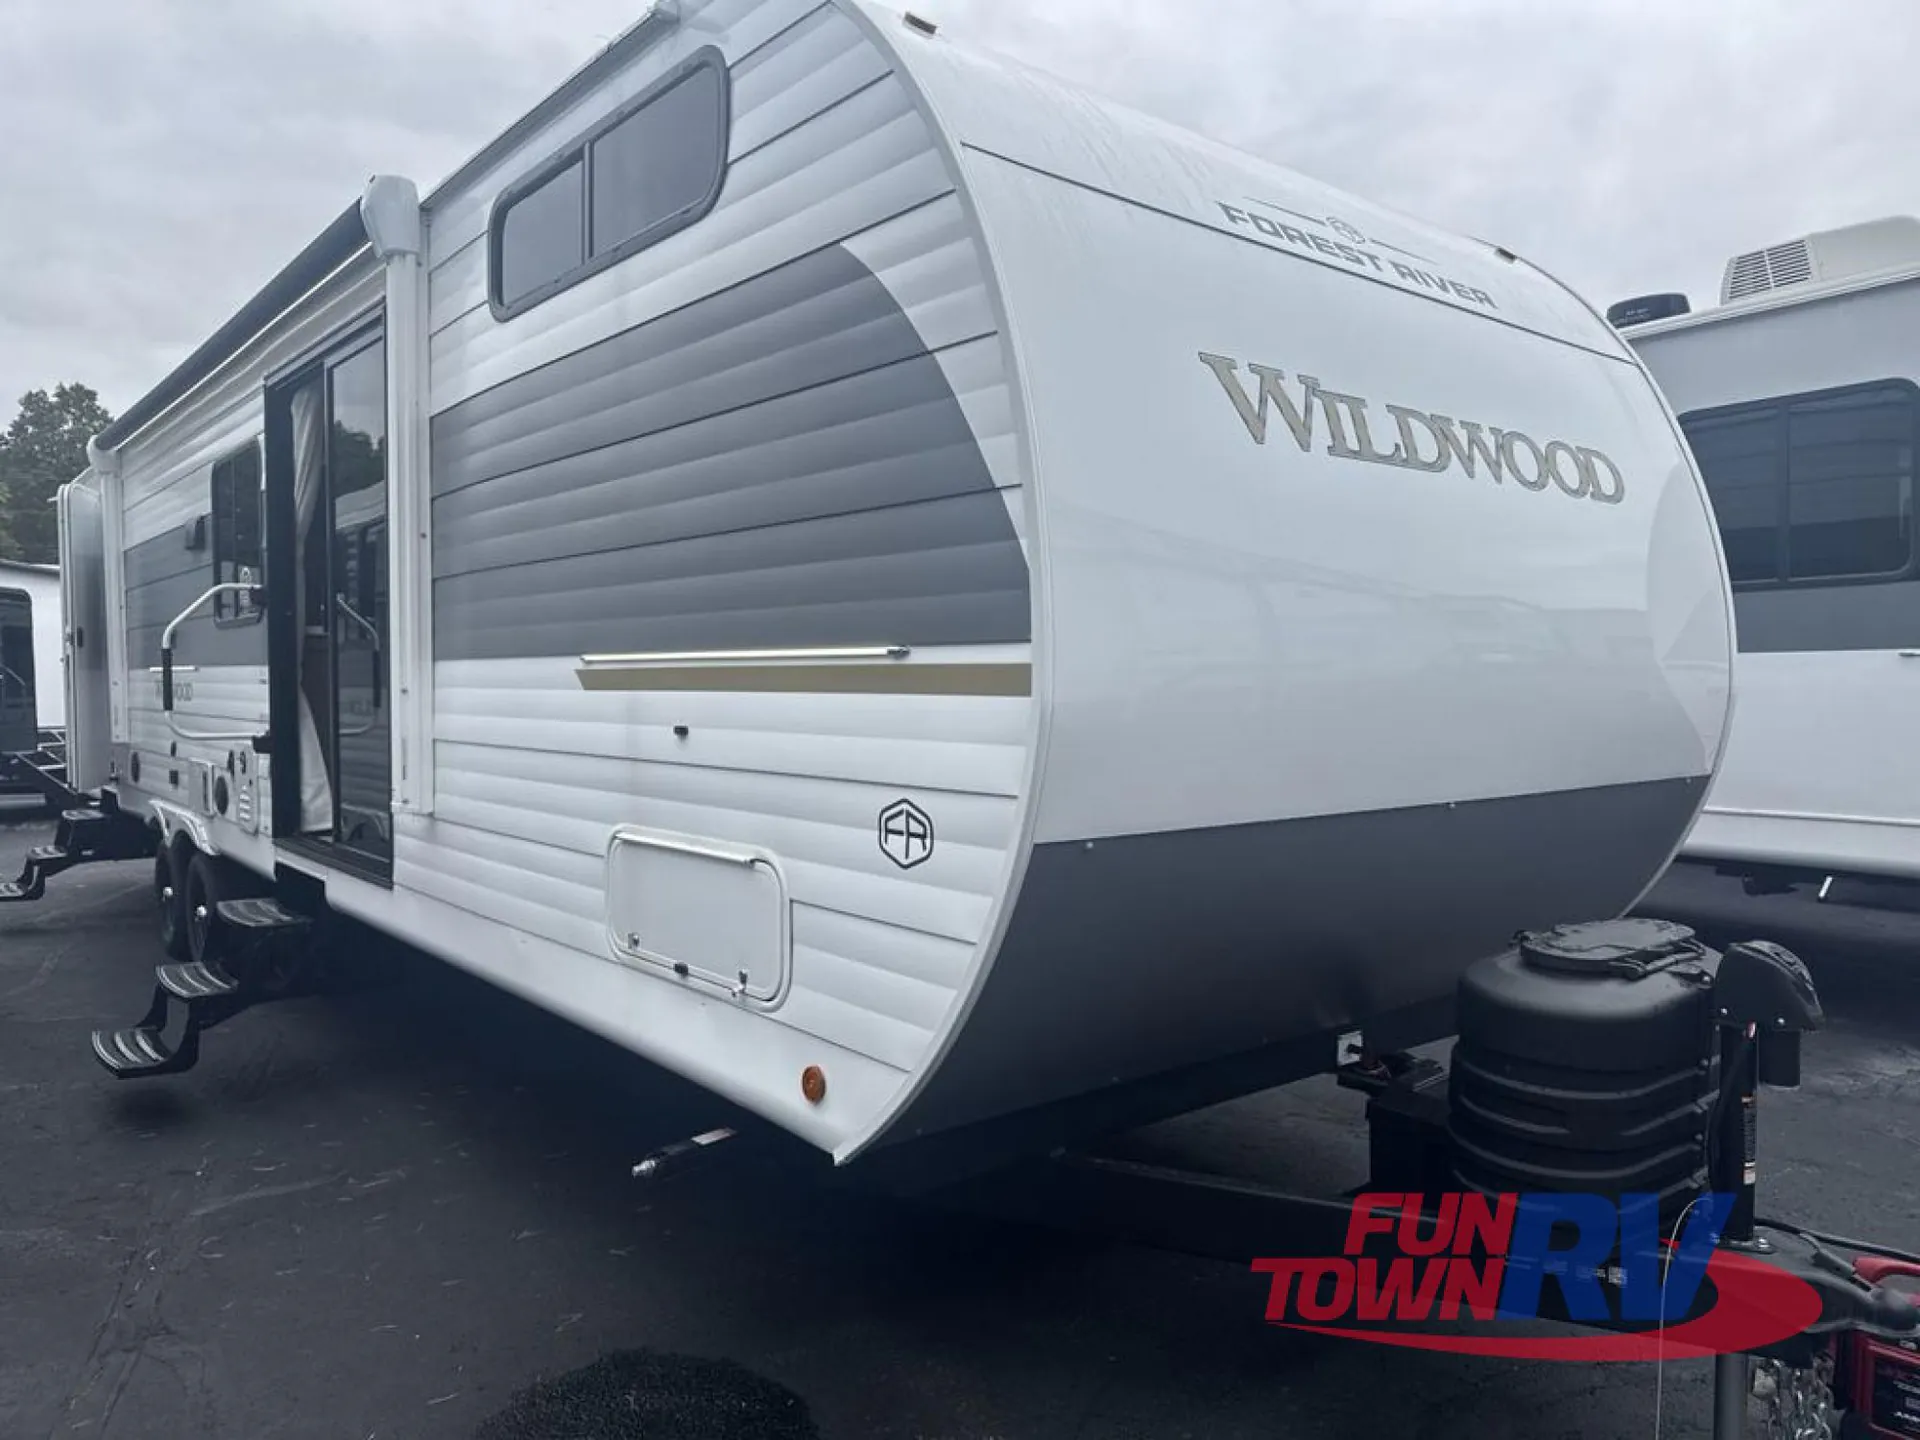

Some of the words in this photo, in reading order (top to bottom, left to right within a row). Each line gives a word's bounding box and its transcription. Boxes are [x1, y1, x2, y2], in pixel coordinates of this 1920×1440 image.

[1214, 200, 1384, 272] FOREST
[1387, 260, 1499, 309] RIVER
[1198, 351, 1625, 504] WILDWOOD
